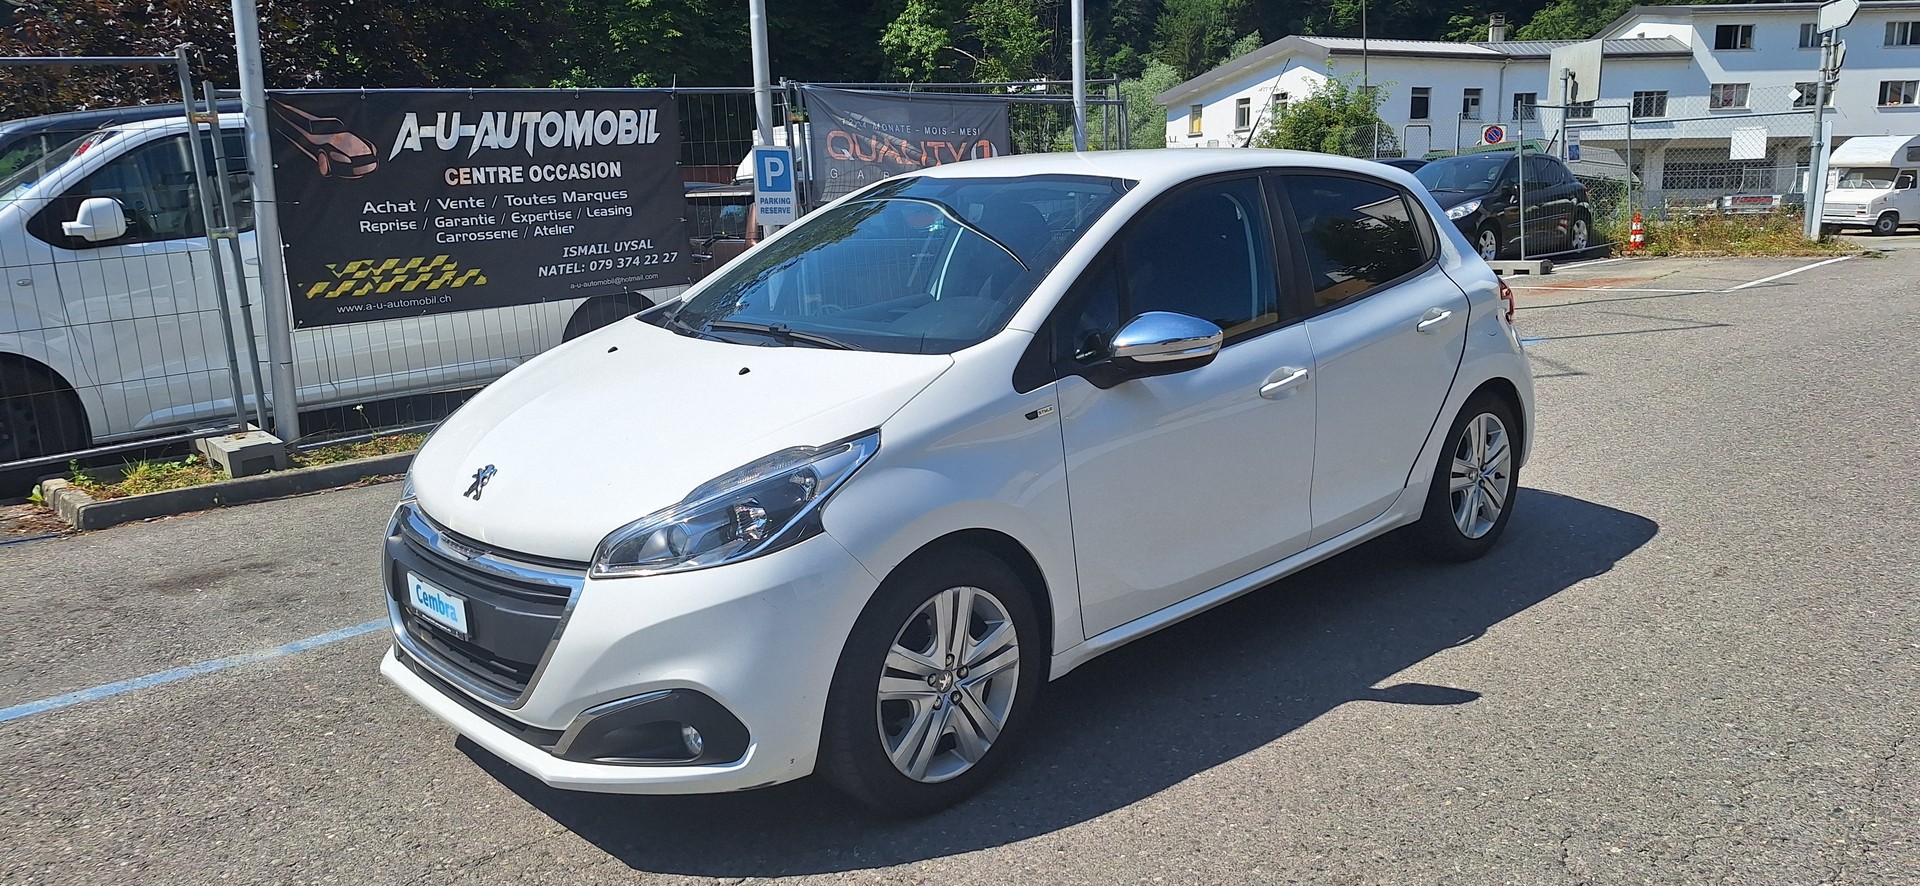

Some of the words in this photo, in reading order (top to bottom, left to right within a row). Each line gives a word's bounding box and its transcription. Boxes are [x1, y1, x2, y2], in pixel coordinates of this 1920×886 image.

[388, 109, 661, 162] A-U-AUTOMOBIL
[872, 122, 911, 133] MONATE
[924, 126, 947, 135] MOIS
[960, 128, 980, 136] MESI
[444, 166, 524, 186] CENTRE
[528, 161, 622, 184] OCCASION
[764, 156, 784, 187] P
[362, 200, 417, 214] Achat
[436, 196, 486, 210] Vente
[503, 193, 557, 207] Toutes
[562, 190, 628, 203] Marques
[360, 219, 418, 234] Reprise
[434, 213, 496, 228] Garantie
[511, 209, 573, 225] Expertise
[586, 205, 633, 218] Leasing
[436, 229, 519, 243] Carrosserie
[533, 224, 575, 237] Atelier
[562, 243, 610, 258] ISMAIL
[614, 239, 654, 253] UYSAL
[538, 264, 586, 277] NATEL:
[589, 259, 613, 271] 079
[616, 256, 640, 268] 374
[643, 254, 659, 265] 22
[662, 252, 678, 263] 27
[570, 273, 659, 289] a-u-automobil@hotmail.com
[336, 295, 452, 313] www.a-u-automobil.ch
[416, 584, 458, 622] Cembra
